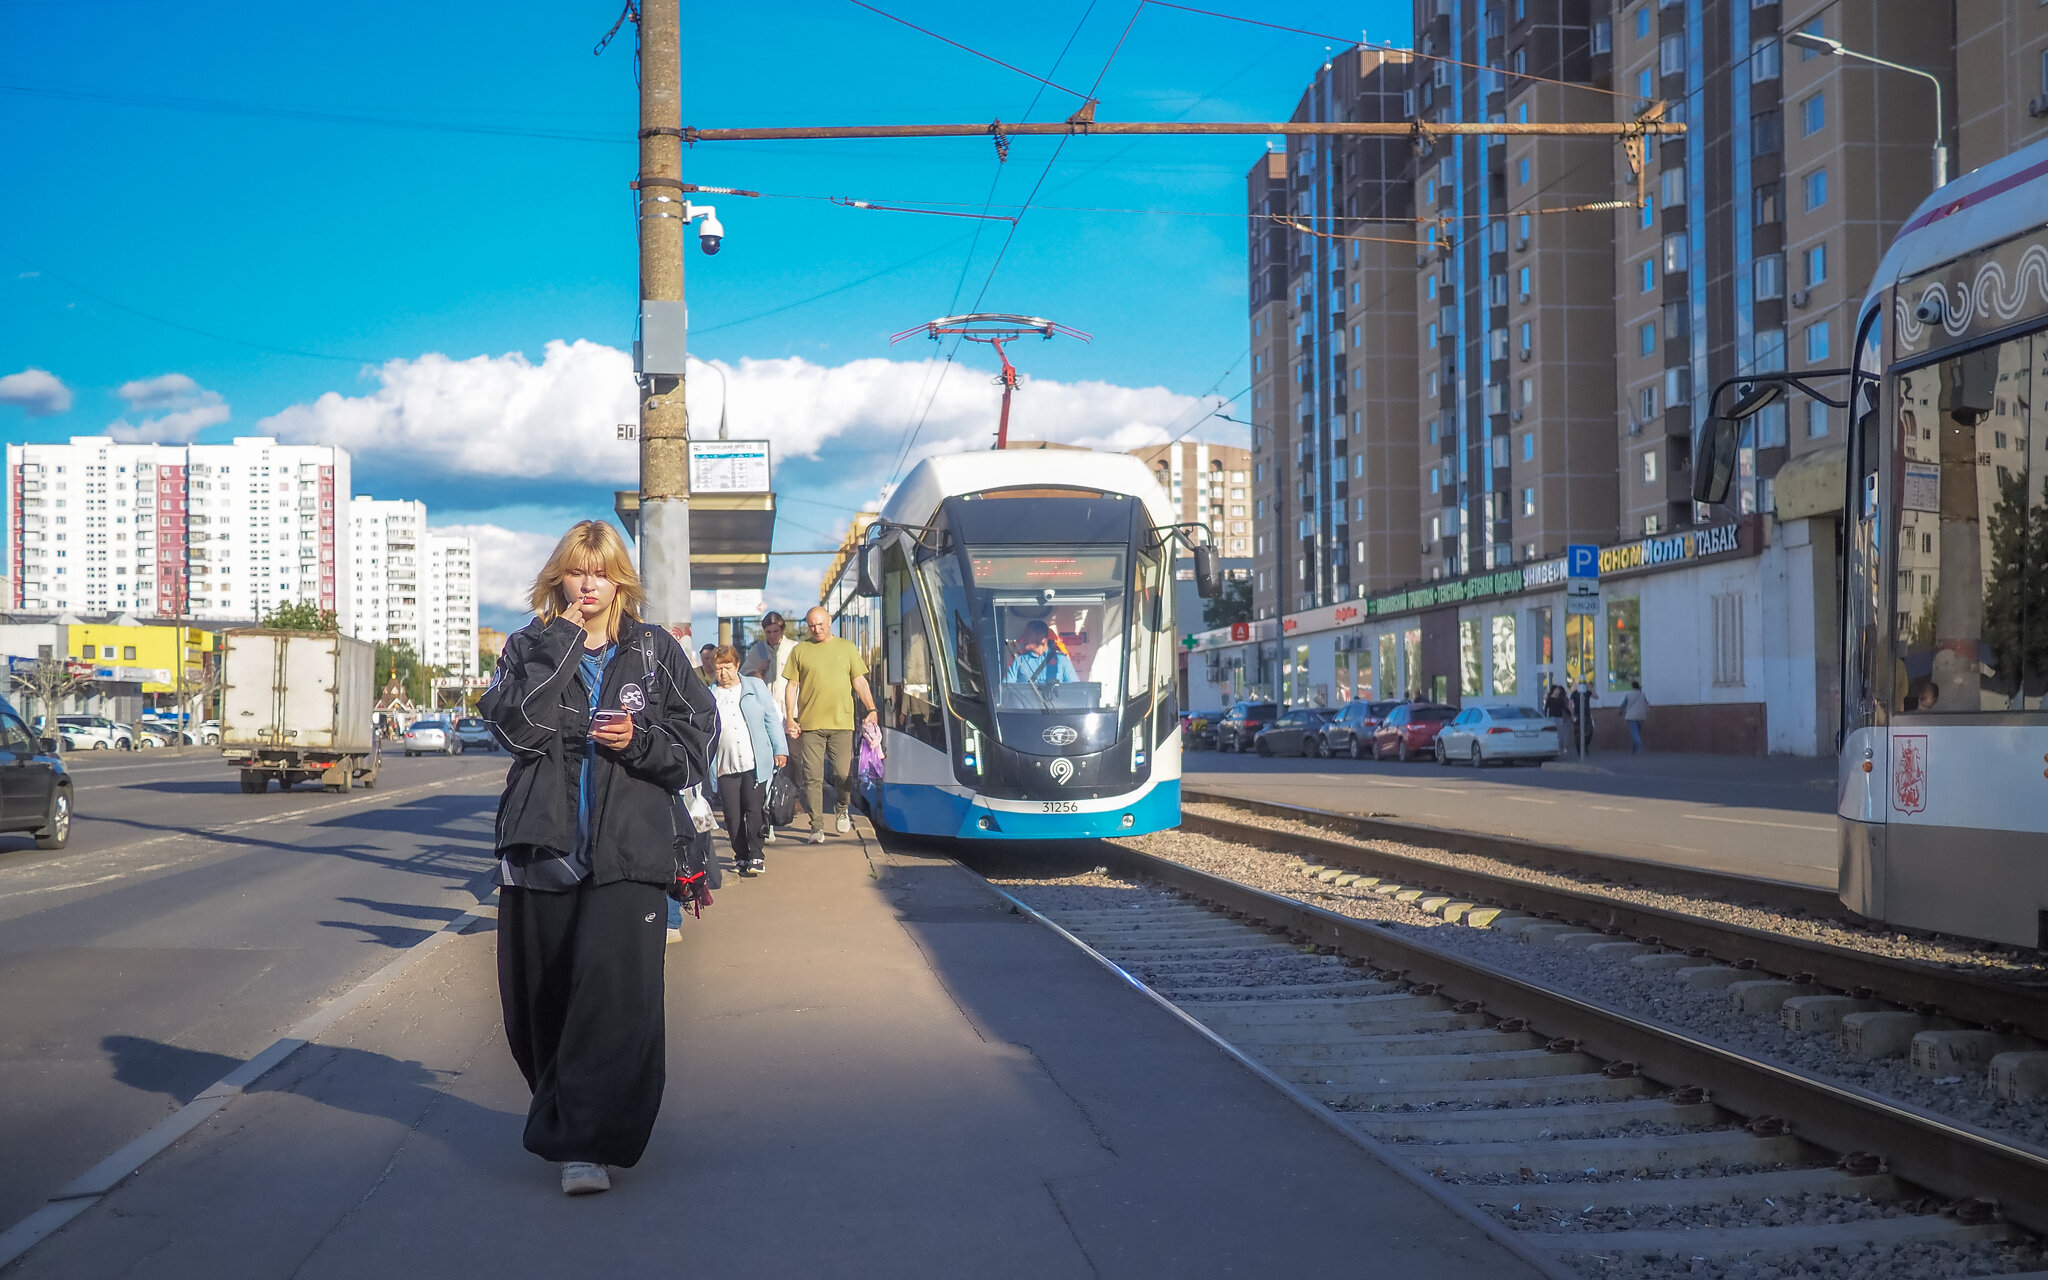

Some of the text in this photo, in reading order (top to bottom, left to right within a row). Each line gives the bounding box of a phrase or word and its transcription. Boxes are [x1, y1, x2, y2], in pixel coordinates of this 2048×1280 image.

[617, 424, 636, 440] 30
[1696, 524, 1738, 556] ТАБАК
[1576, 549, 1592, 573] P
[1523, 561, 1568, 587] УНИВЕРМ
[1042, 802, 1078, 813] 31256
